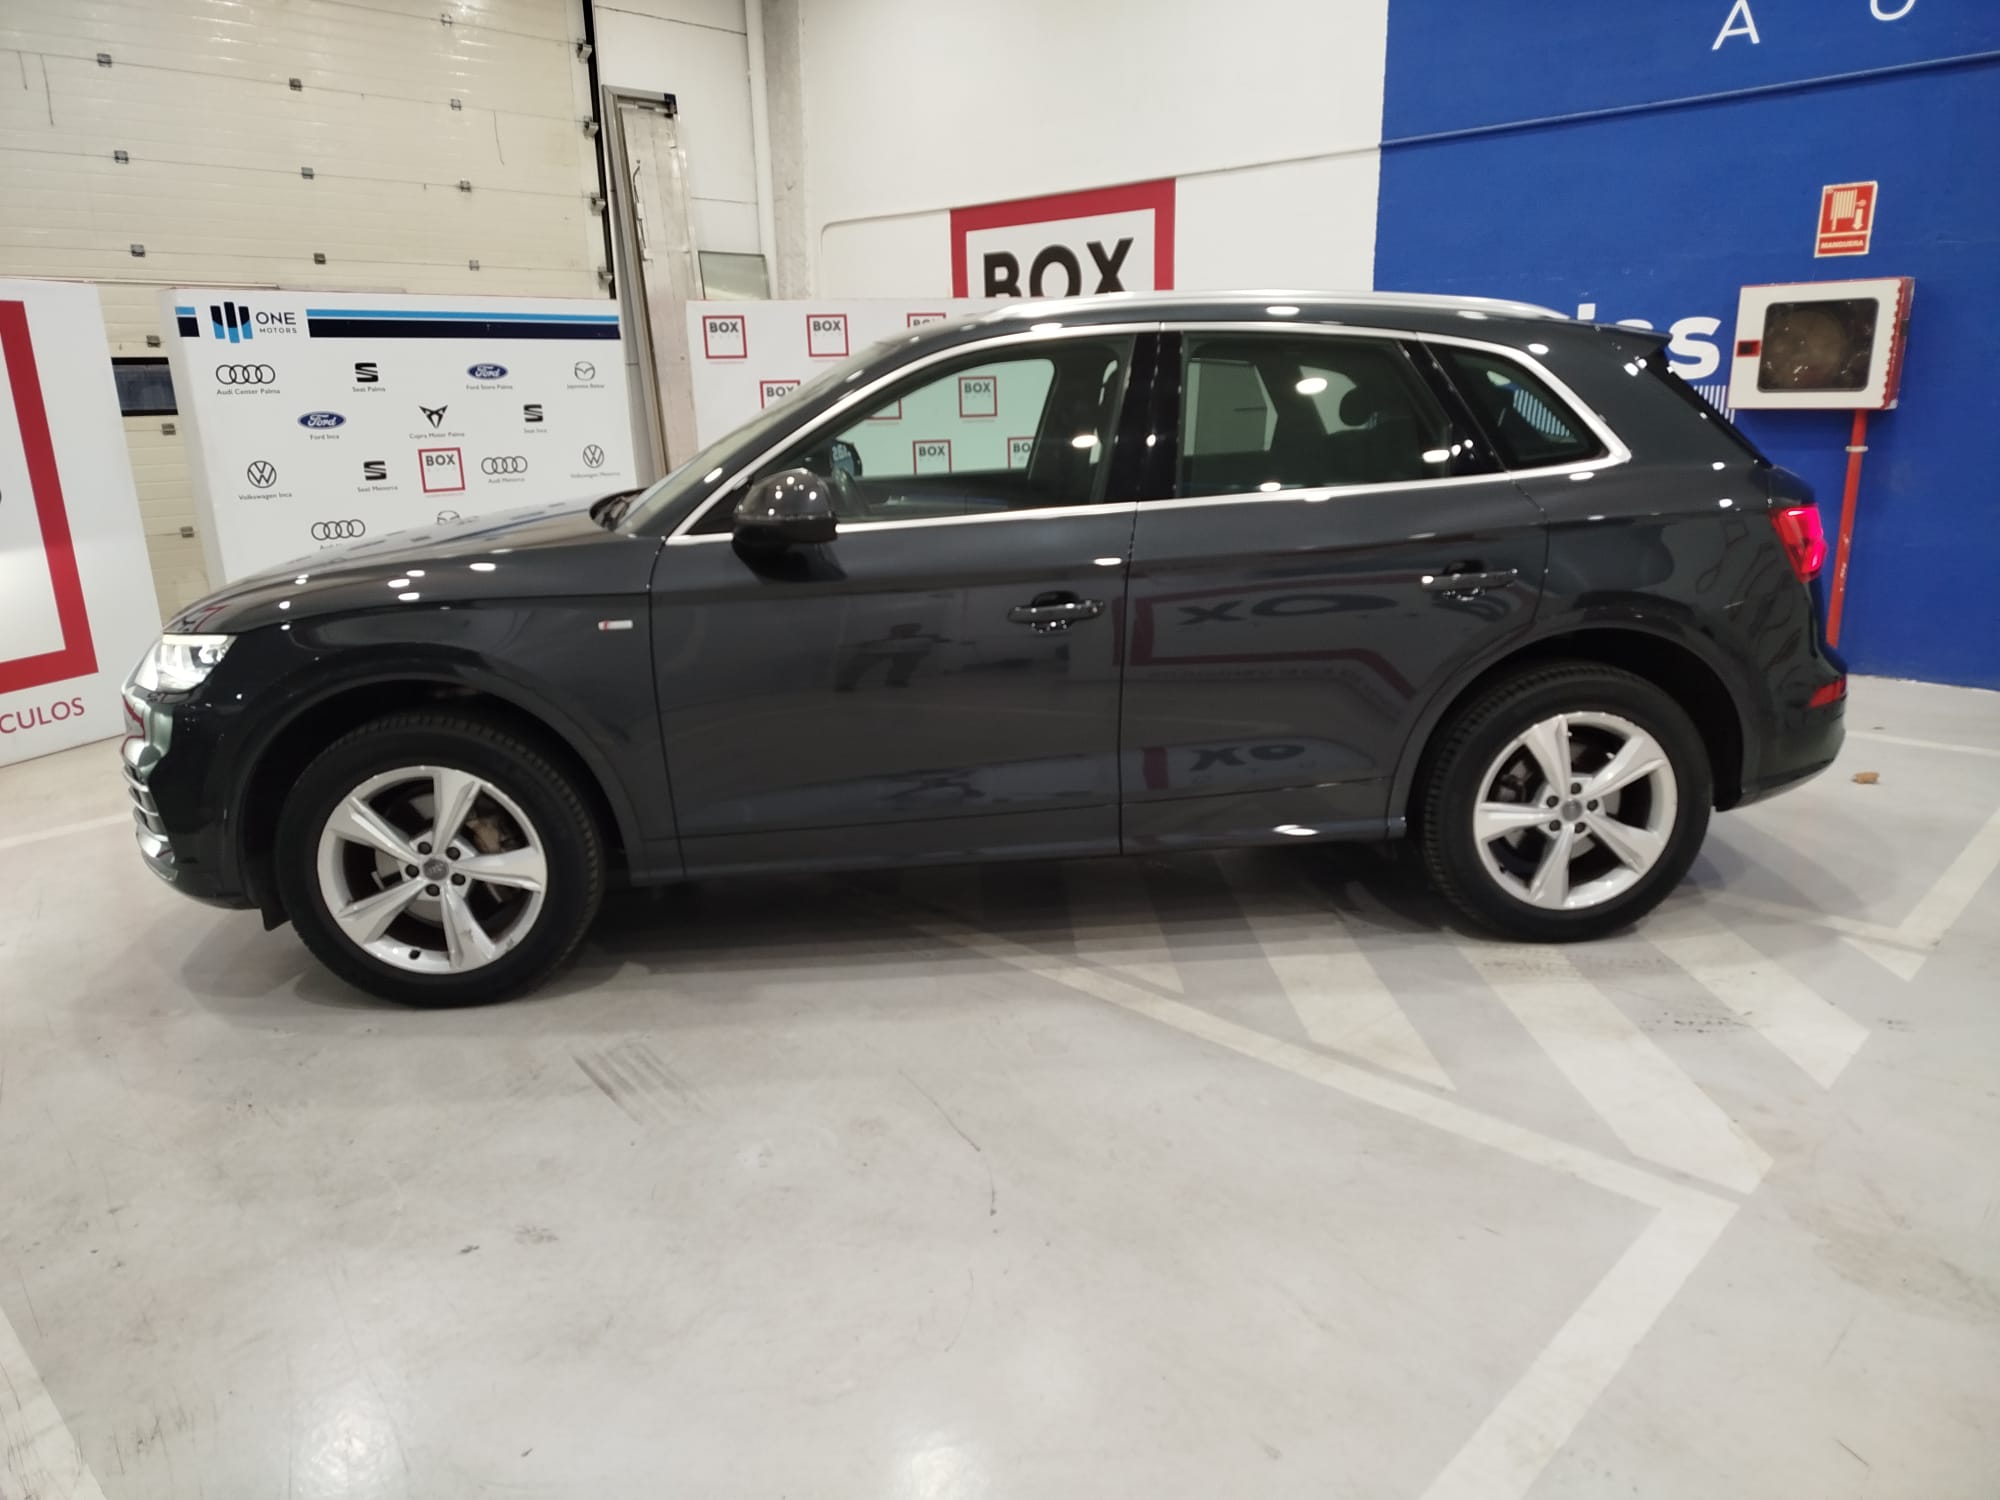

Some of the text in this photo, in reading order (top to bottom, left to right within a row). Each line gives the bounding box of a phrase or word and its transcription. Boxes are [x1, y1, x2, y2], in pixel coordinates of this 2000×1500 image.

[983, 237, 1134, 298] BOX
[255, 311, 297, 325] ONE
[708, 321, 739, 334] BOX
[812, 319, 842, 332] BOX
[216, 388, 233, 396] Audi
[260, 387, 281, 395] Palma
[963, 382, 991, 394] BOX
[307, 414, 337, 426] Ford
[918, 446, 946, 457] BOX
[1013, 442, 1032, 454] BO
[425, 453, 456, 467] BOX
[0, 697, 85, 734] CULOS
